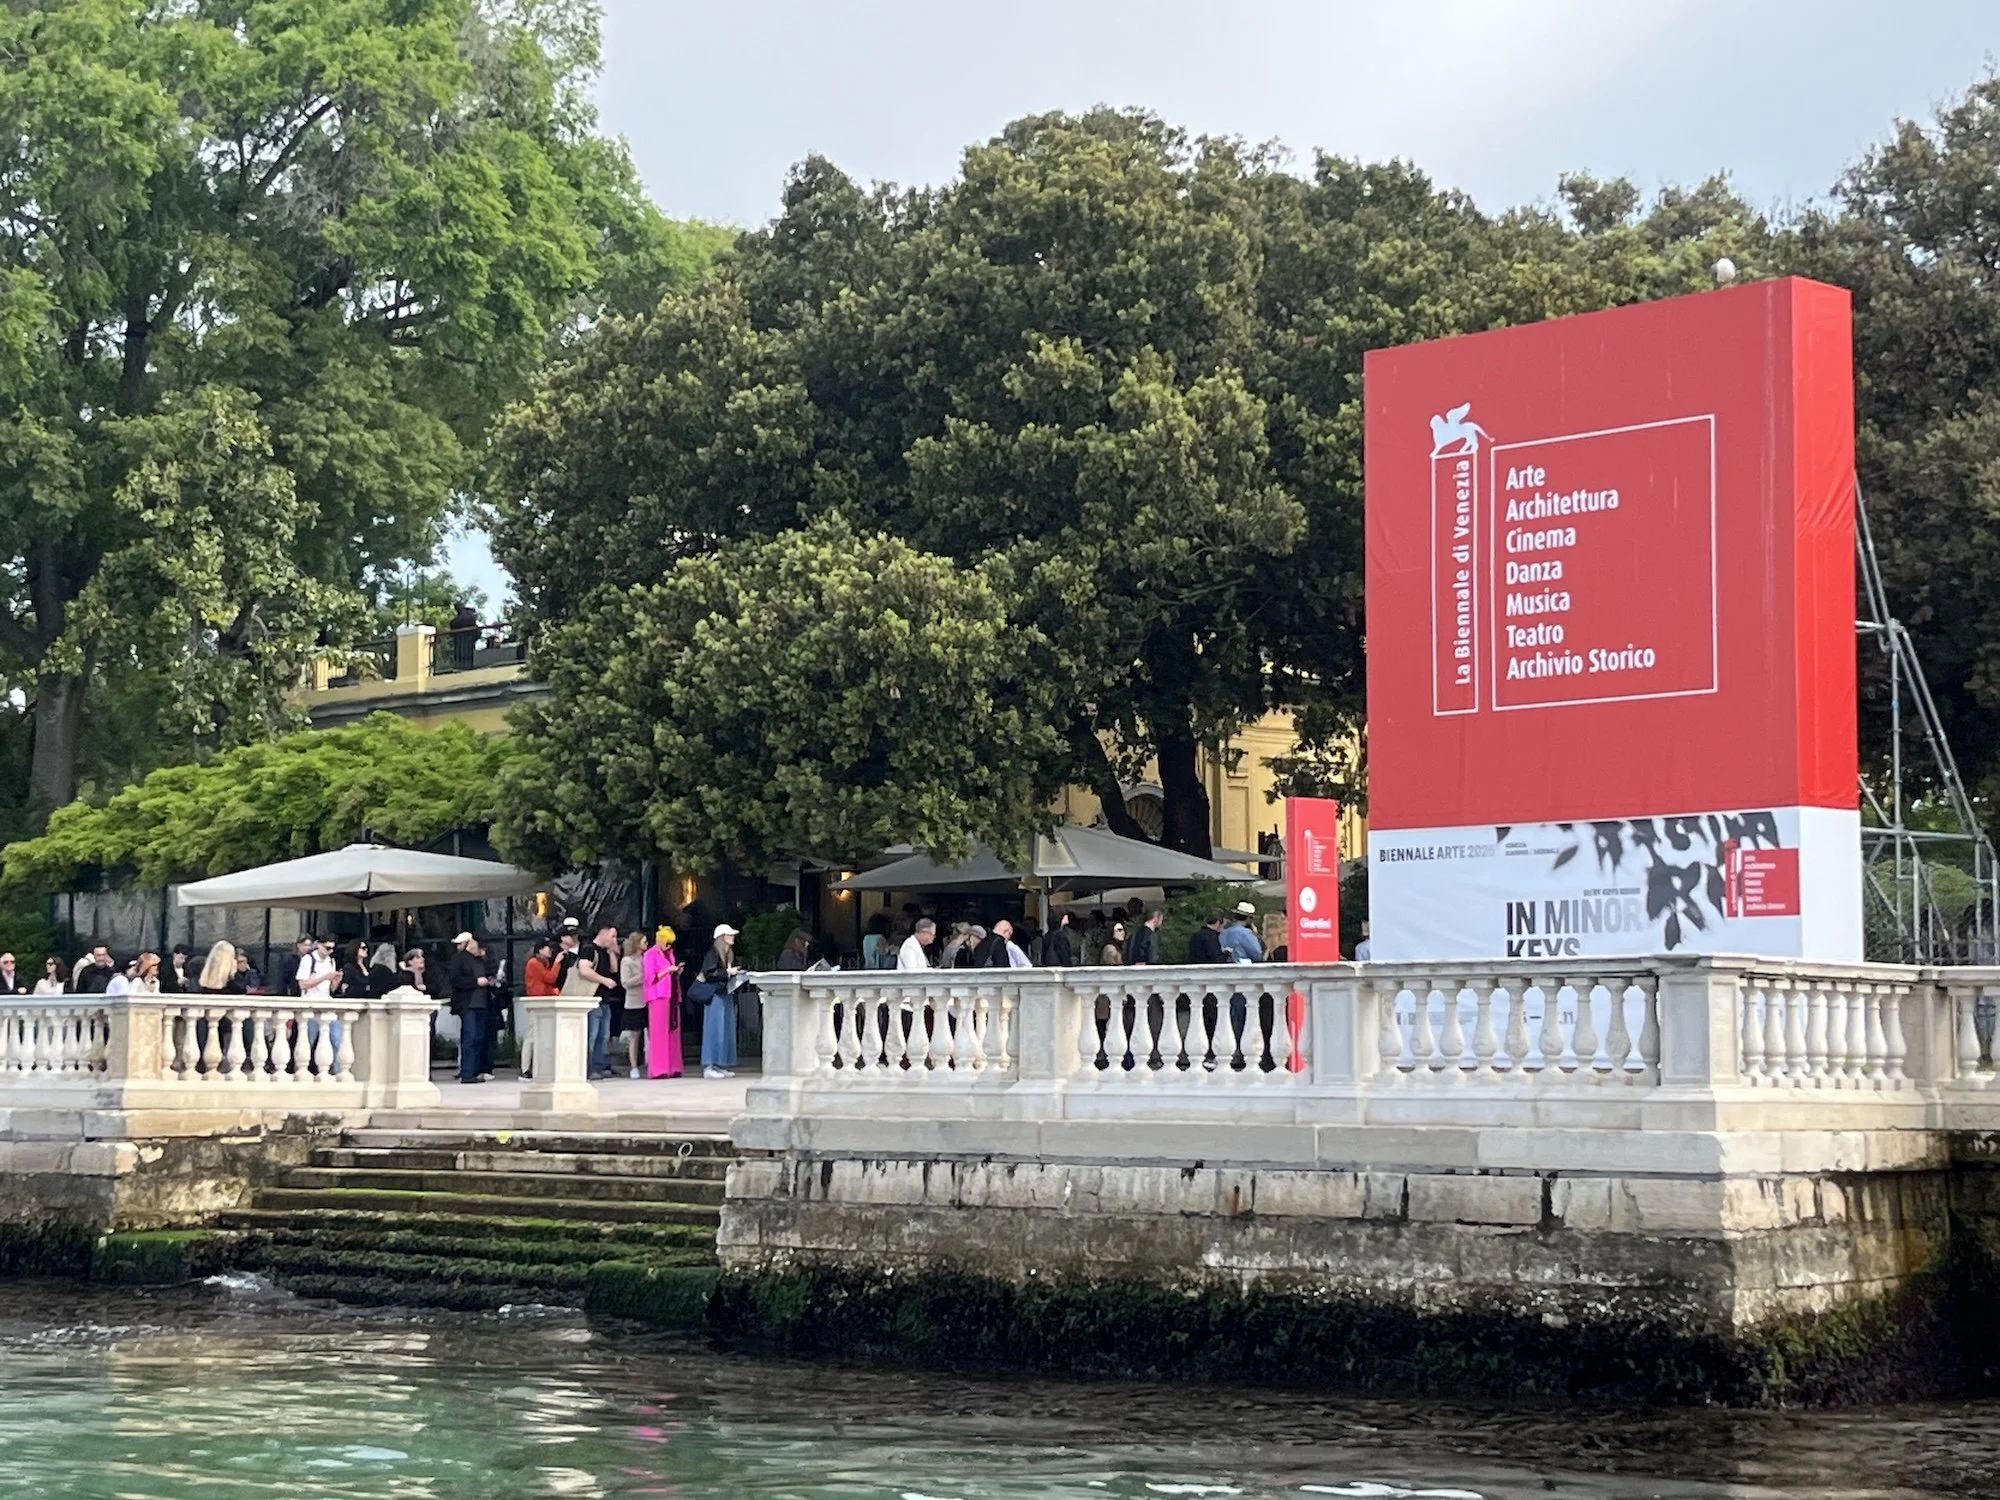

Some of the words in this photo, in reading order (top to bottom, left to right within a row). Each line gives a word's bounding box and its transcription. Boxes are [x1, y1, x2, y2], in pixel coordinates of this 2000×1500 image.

[1505, 465, 1545, 490] Arte
[1452, 460, 1470, 539] Venezia
[1505, 489, 1619, 522] Architettura
[1505, 527, 1576, 553] Cinema
[1452, 544, 1470, 564] di
[1505, 560, 1563, 585] Danza
[1453, 569, 1470, 658] Biennale
[1505, 587, 1571, 617] Musica
[1505, 623, 1564, 648] Teatro
[1455, 664, 1471, 685] La
[1506, 649, 1583, 680] Archivio
[1588, 643, 1655, 674] Storico
[1379, 847, 1434, 862] BIENNALE
[1436, 845, 1466, 860] ARTE
[1506, 901, 1536, 935] IN
[1545, 898, 1643, 934] MINOR
